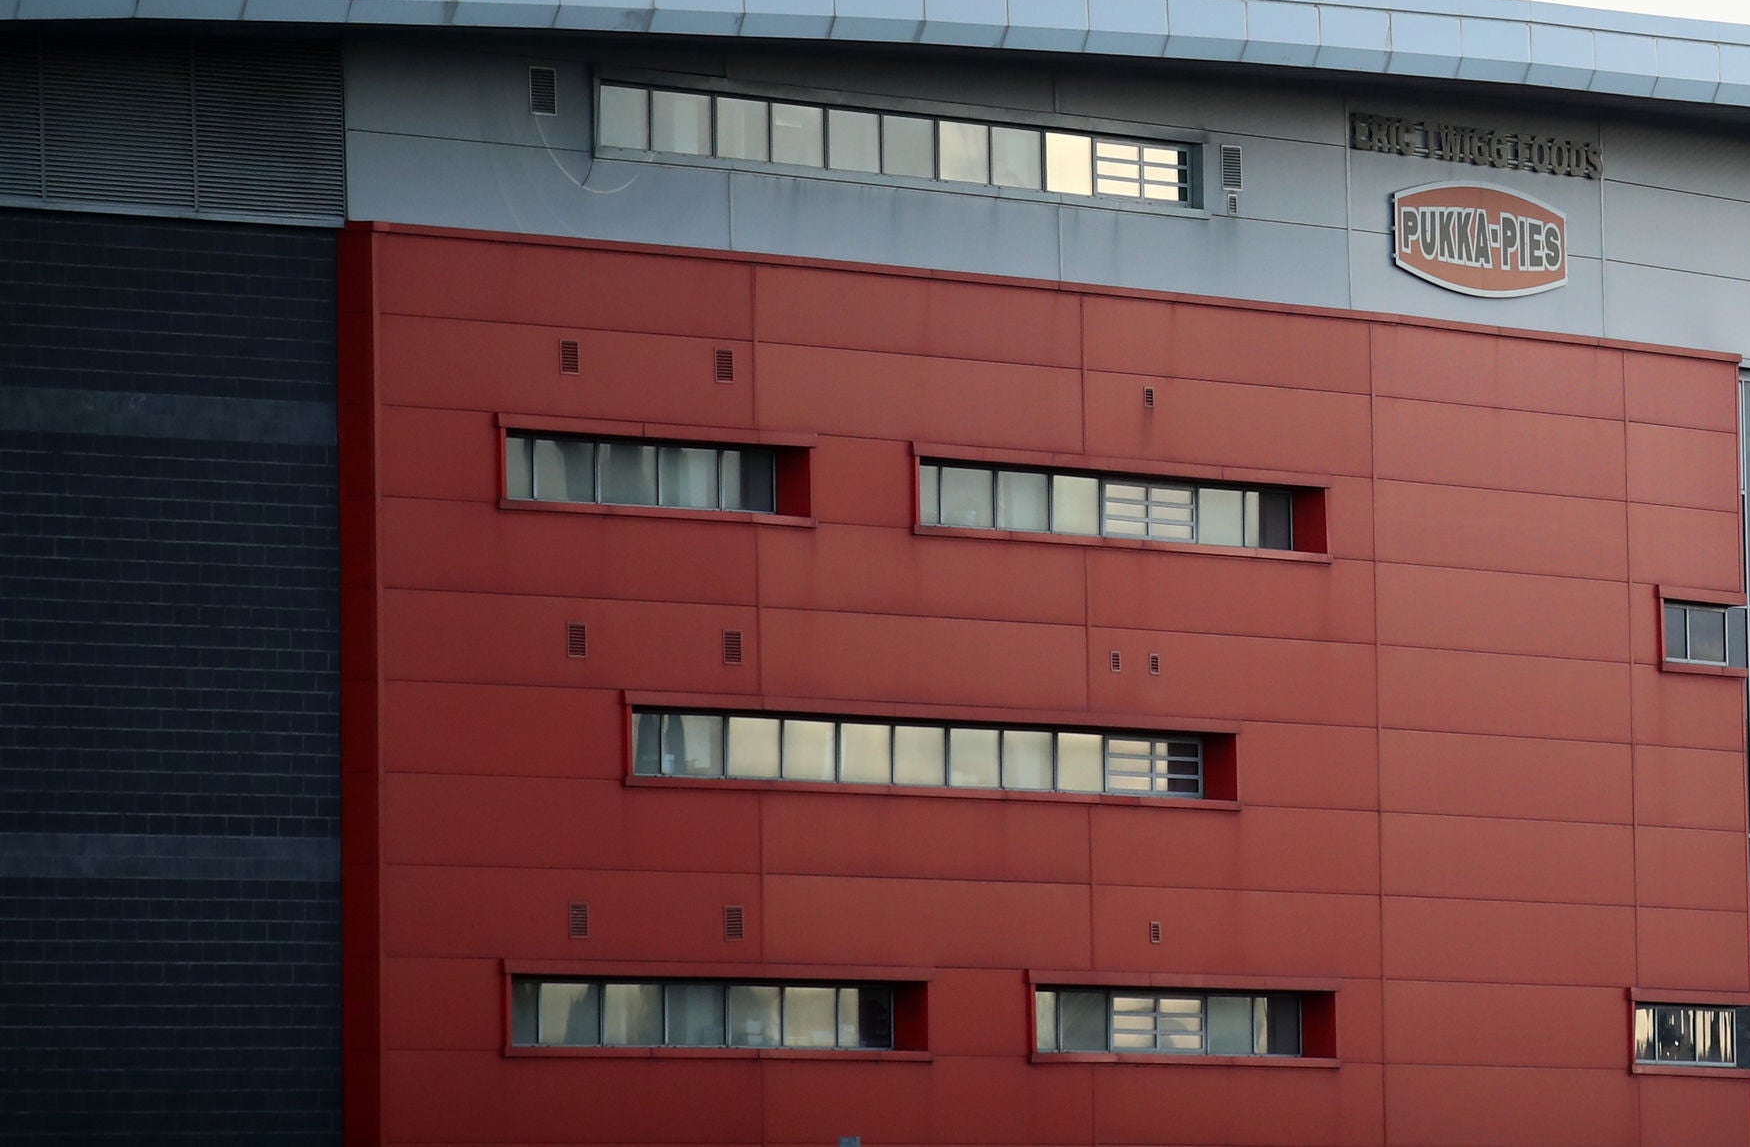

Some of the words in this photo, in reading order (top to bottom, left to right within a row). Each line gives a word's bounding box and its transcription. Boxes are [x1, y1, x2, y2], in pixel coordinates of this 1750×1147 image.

[1350, 112, 1416, 157] ERIC
[1422, 121, 1508, 169] TWIGG
[1517, 133, 1603, 181] FOODS
